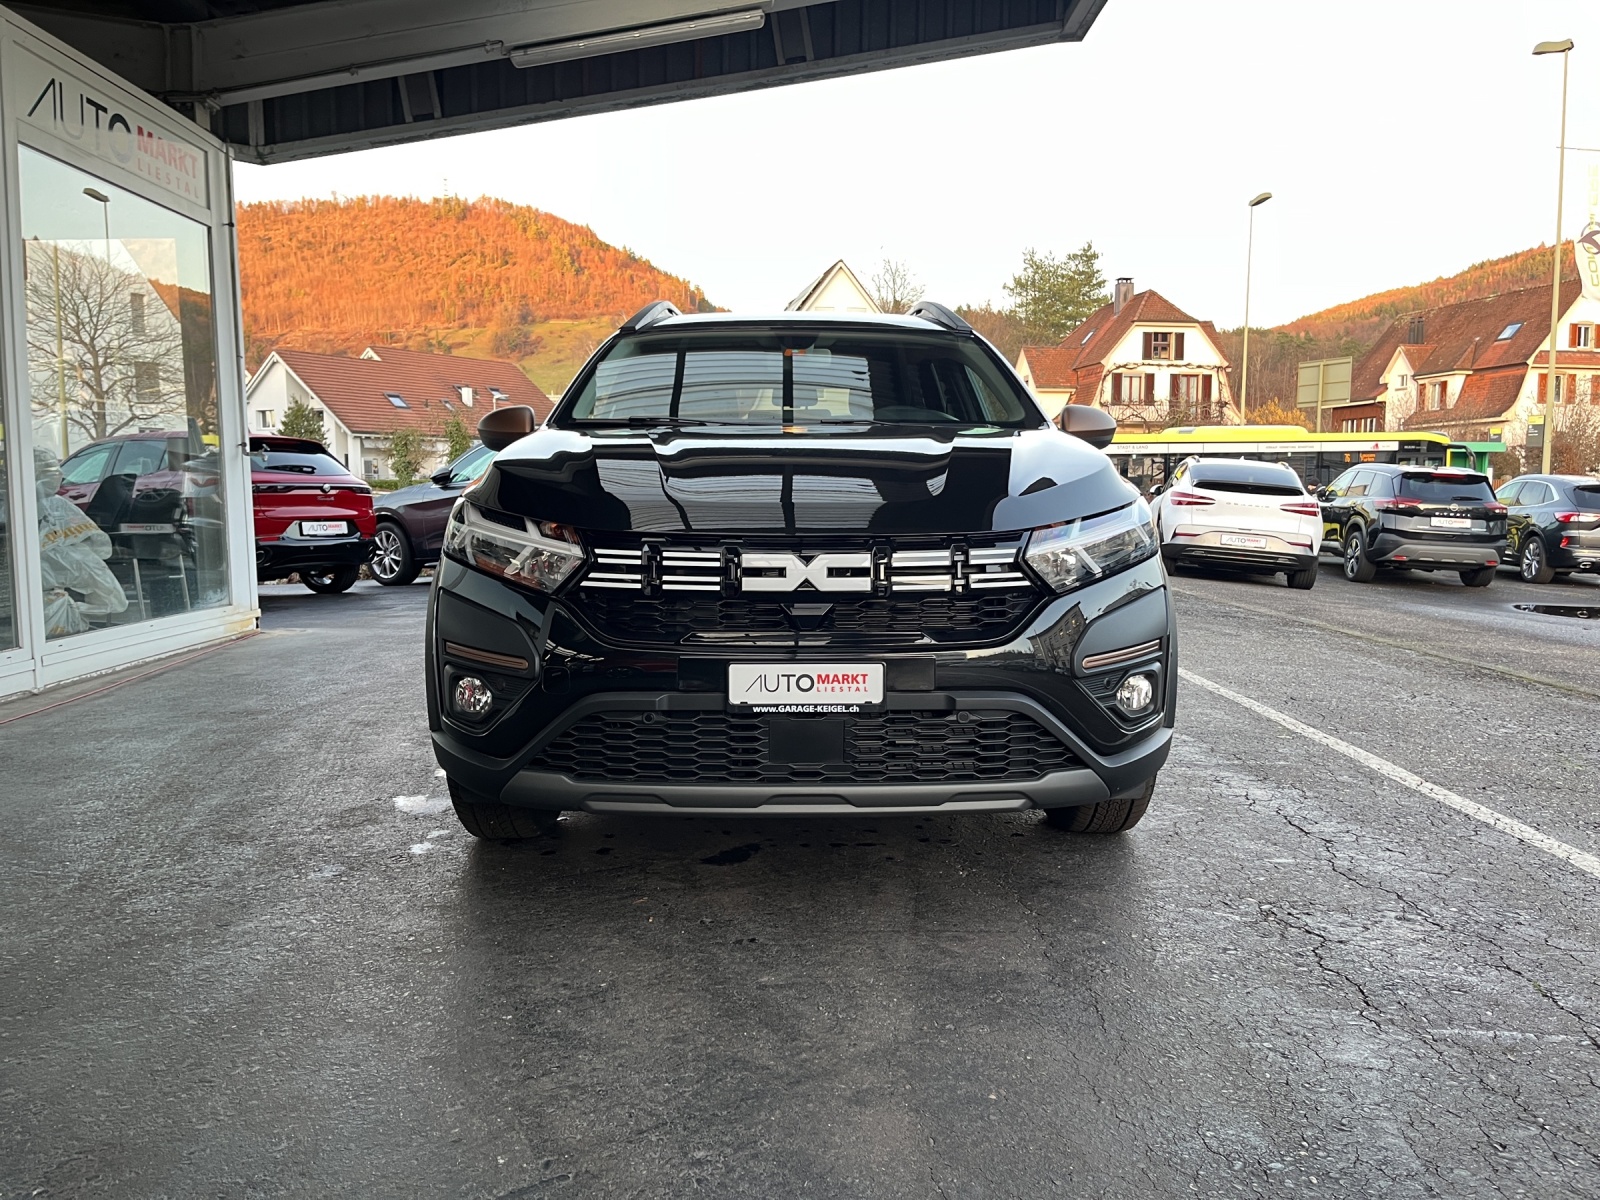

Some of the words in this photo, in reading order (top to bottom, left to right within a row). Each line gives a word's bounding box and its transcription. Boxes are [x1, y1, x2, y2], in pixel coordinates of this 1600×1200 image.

[27, 78, 132, 164] AUTO
[137, 125, 198, 179] MARKT
[137, 158, 199, 199] LIESTAL
[745, 673, 815, 693] AUTO
[816, 673, 868, 685] MARKT
[752, 705, 860, 713] www.GARAGE-KEIGEL.ch
